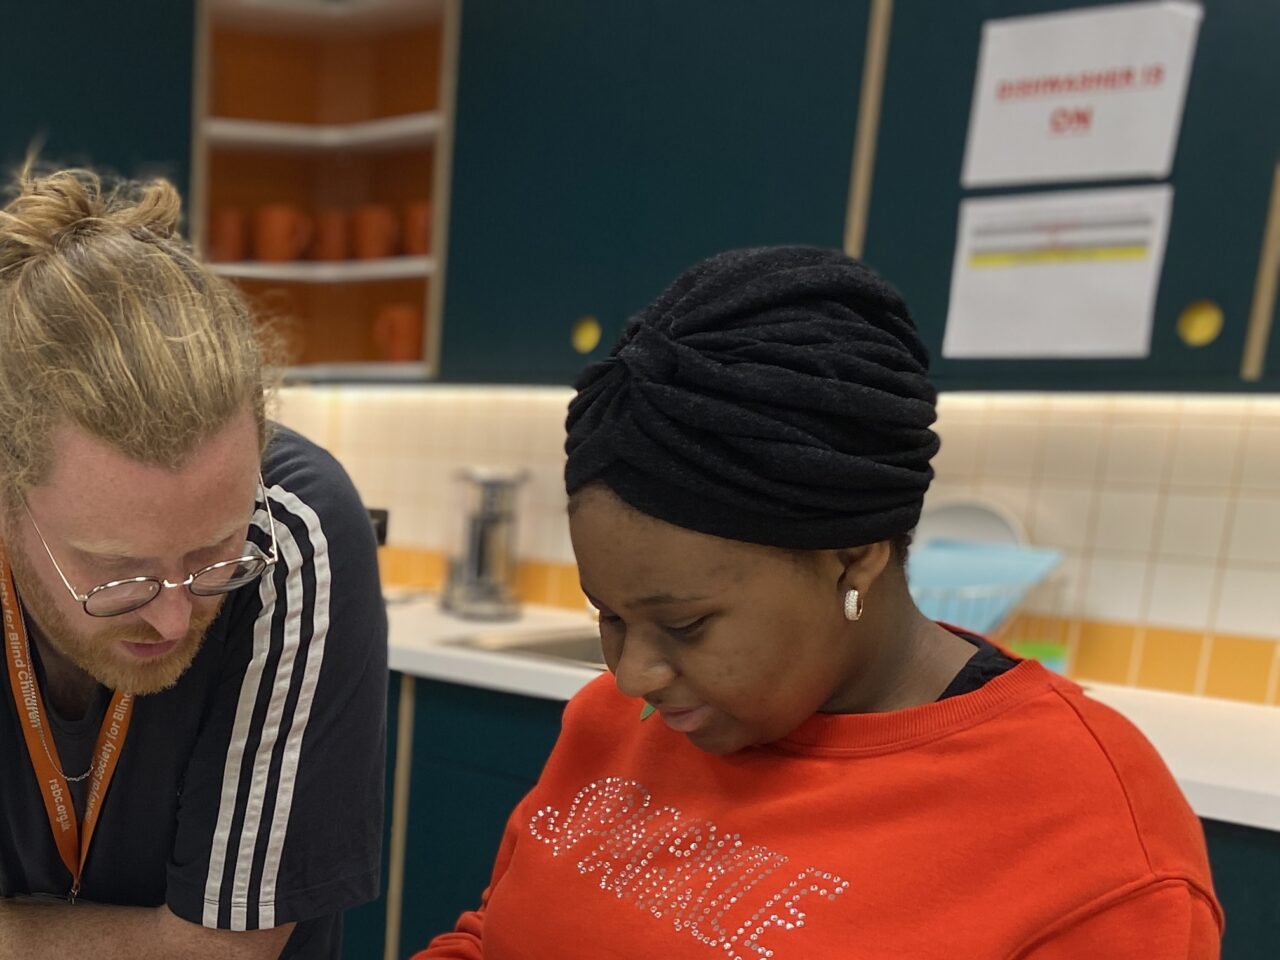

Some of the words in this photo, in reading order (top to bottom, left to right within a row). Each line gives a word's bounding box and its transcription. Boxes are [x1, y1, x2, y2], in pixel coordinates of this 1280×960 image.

[997, 66, 1134, 102] DISHWASHER
[1049, 105, 1093, 135] ON
[5, 609, 15, 630] for
[8, 632, 26, 669] Blind
[17, 670, 41, 729] Children
[86, 778, 101, 807] Royal
[95, 739, 116, 780] Society
[106, 721, 121, 740] for
[49, 779, 71, 832] rsbc.org.uk
